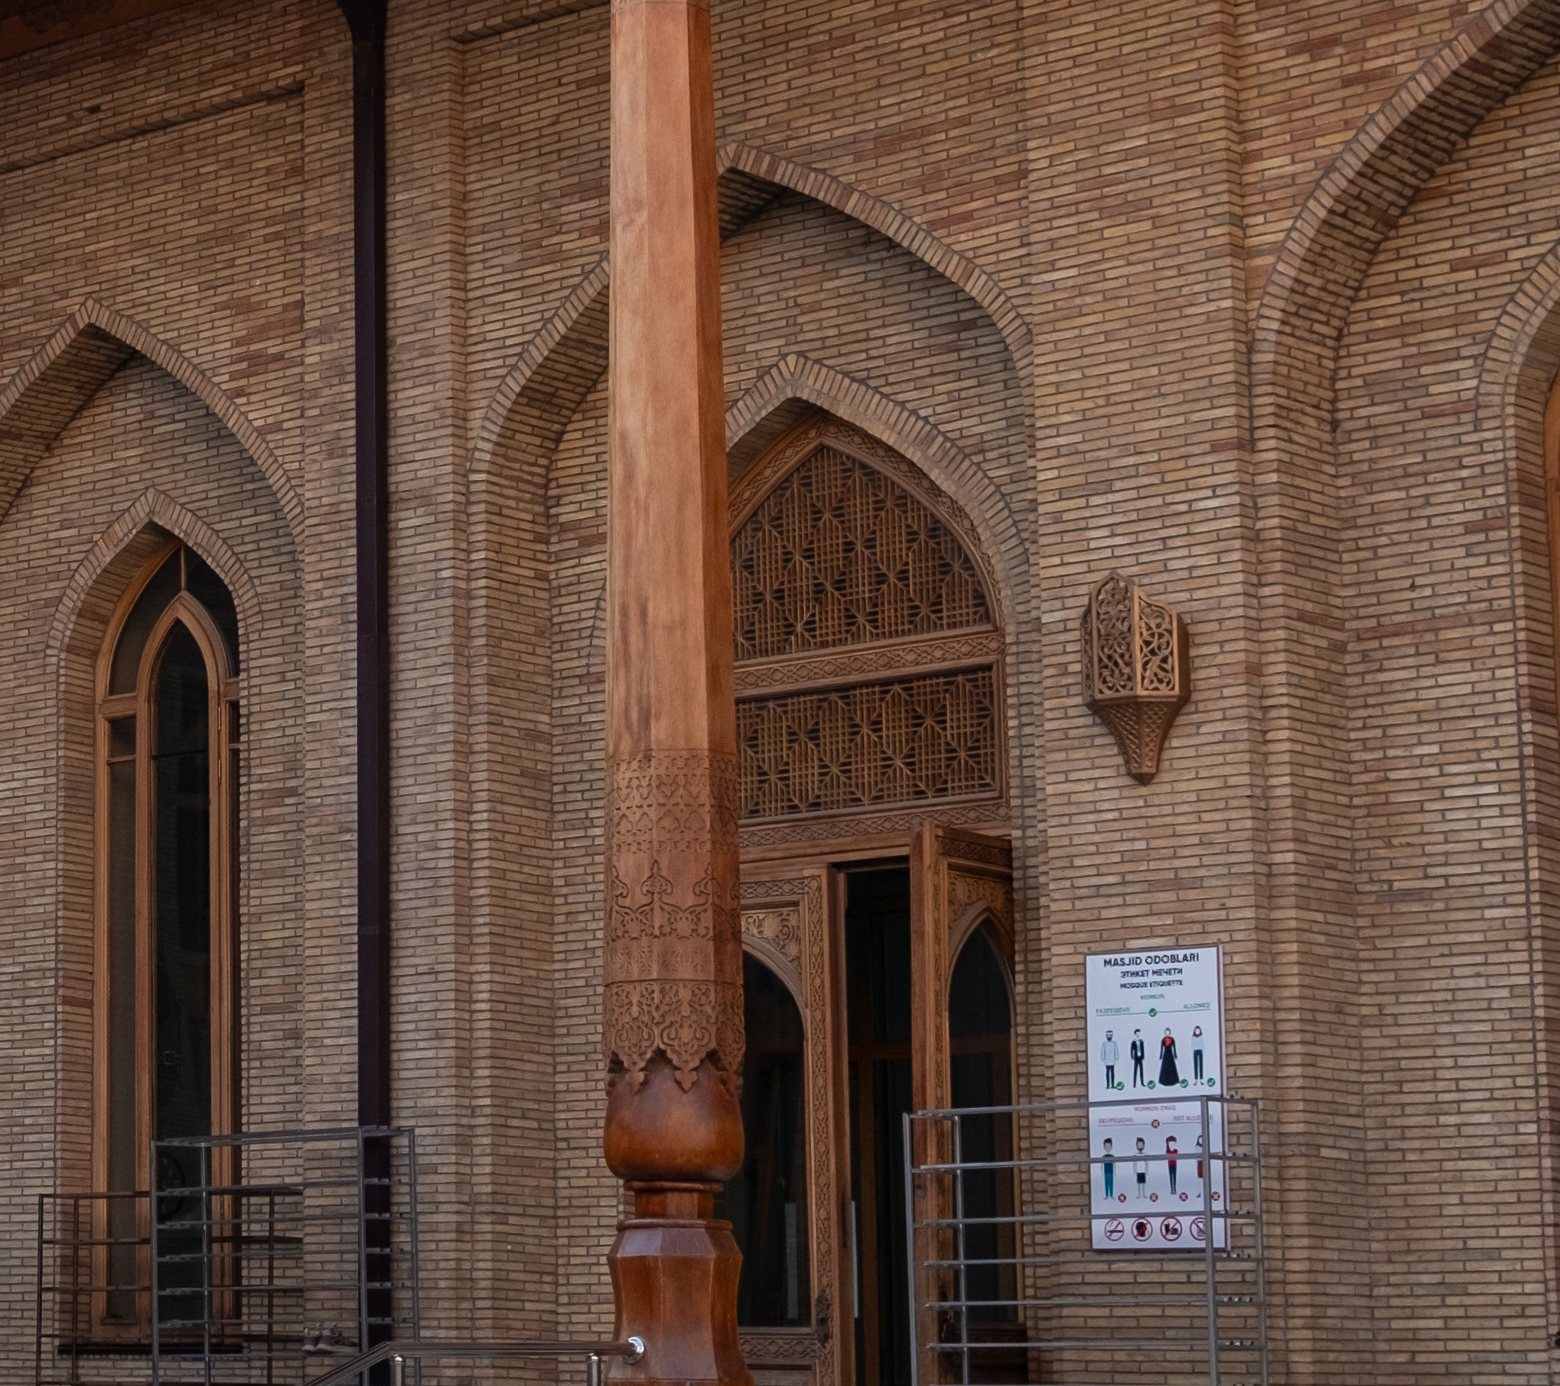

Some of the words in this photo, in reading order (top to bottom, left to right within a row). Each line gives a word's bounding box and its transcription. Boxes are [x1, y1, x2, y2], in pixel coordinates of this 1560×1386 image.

[1103, 956, 1142, 968] MASJID
[1144, 952, 1200, 965] ODOBLARI
[1120, 969, 1149, 978] ЭТИКЕТ
[1151, 967, 1183, 977] МЕЧЕТИ
